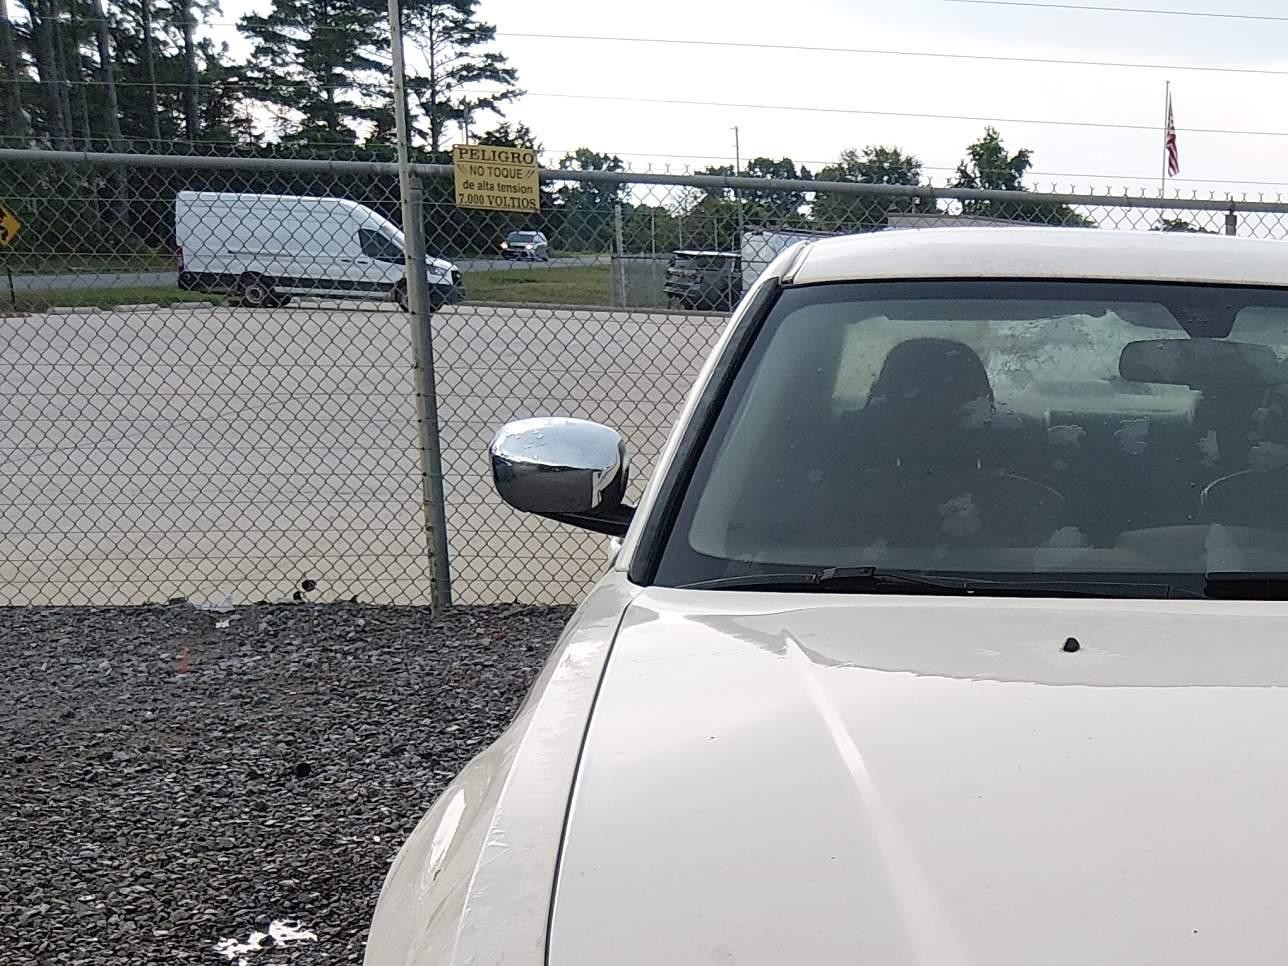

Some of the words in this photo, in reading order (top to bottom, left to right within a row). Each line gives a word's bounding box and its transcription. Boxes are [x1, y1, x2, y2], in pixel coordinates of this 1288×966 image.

[459, 148, 534, 164] PELIGRO
[469, 164, 485, 177] NO
[487, 166, 523, 179] TOQUE
[462, 179, 475, 190] de
[477, 180, 495, 191] alta
[497, 182, 533, 194] tension
[486, 195, 536, 209] VOLTIOS
